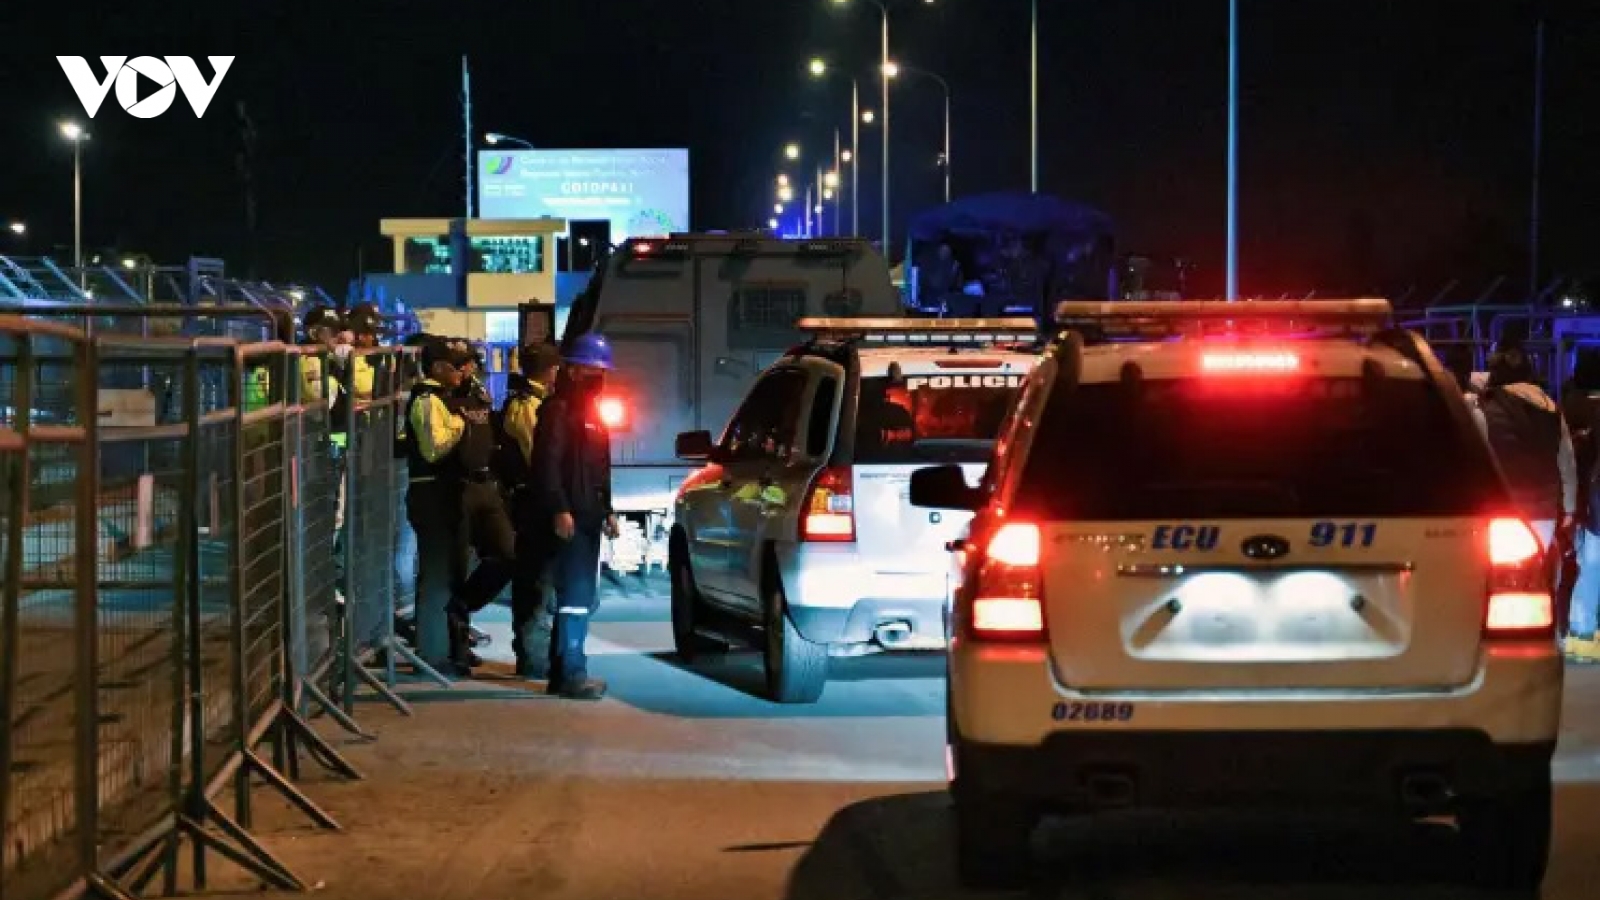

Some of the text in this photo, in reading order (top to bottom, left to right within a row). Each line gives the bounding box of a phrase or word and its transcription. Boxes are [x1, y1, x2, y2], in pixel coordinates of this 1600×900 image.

[906, 375, 1024, 390] POLICI
[1152, 525, 1220, 549] ECU
[1308, 522, 1376, 547] 911
[1052, 701, 1134, 720] 02689
